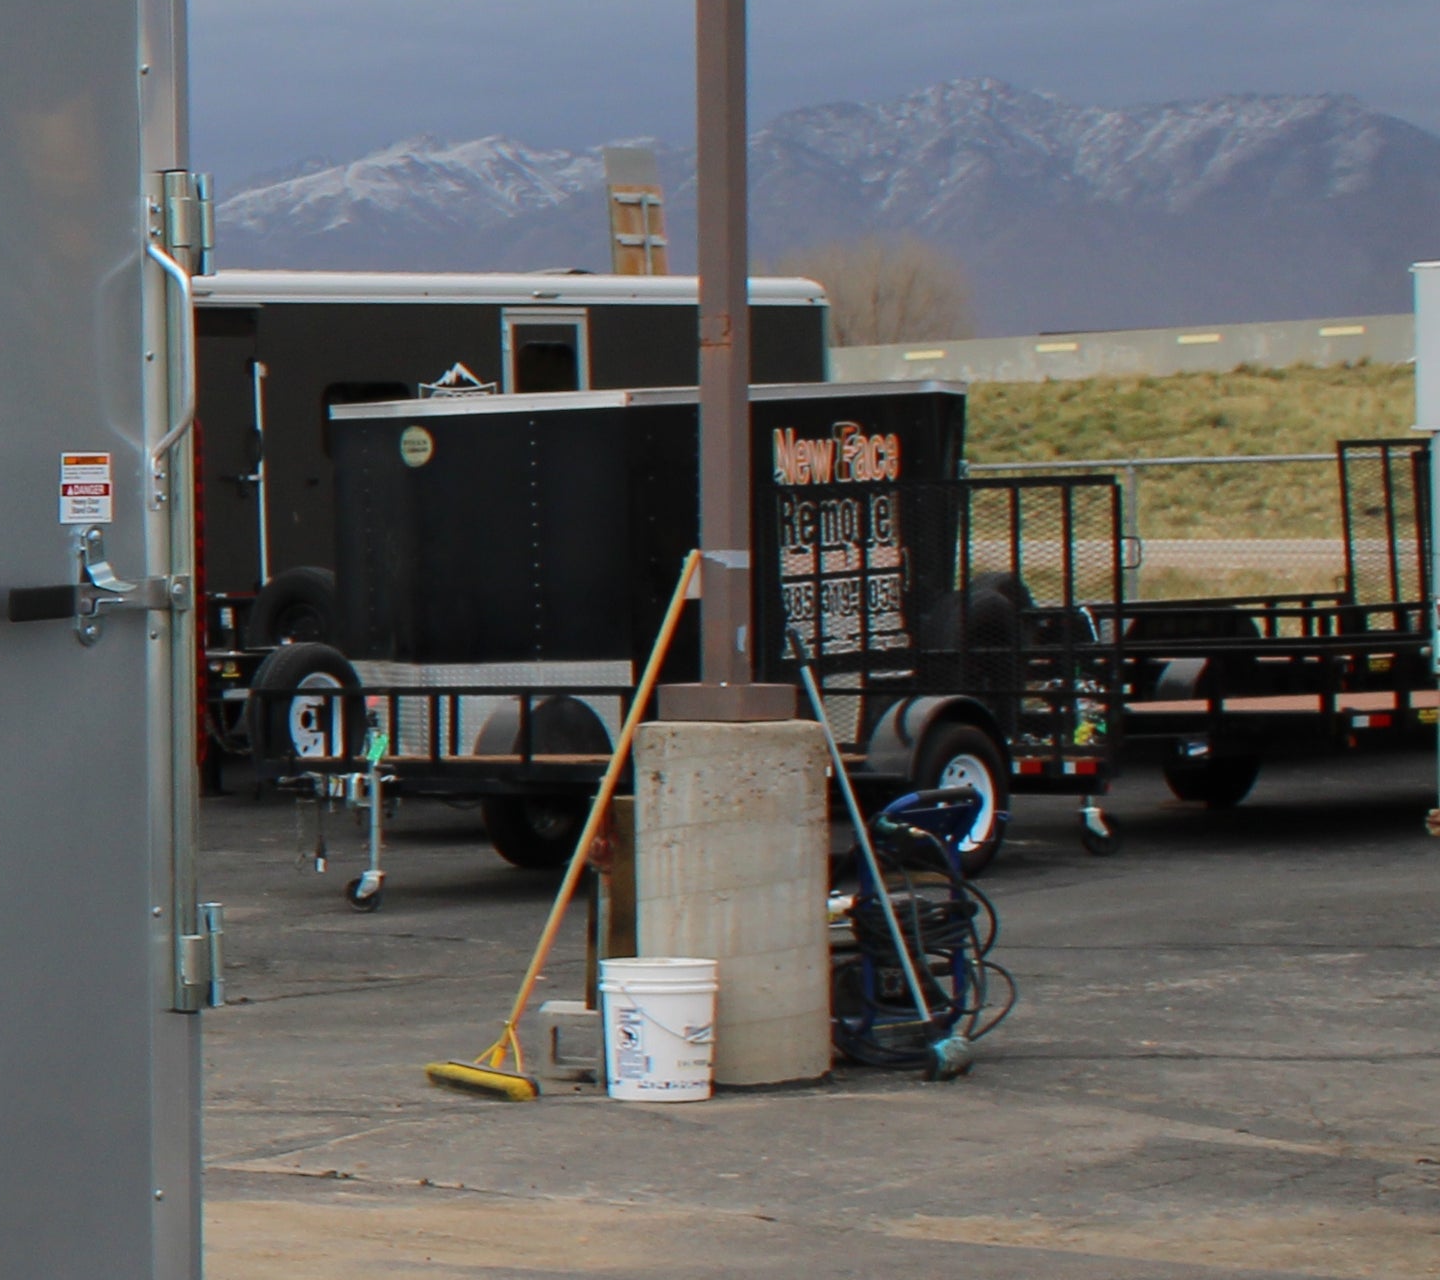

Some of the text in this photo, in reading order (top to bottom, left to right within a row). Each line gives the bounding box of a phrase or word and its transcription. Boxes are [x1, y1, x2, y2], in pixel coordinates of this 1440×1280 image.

[773, 421, 902, 486] New Face
[73, 484, 104, 496] DANGER
